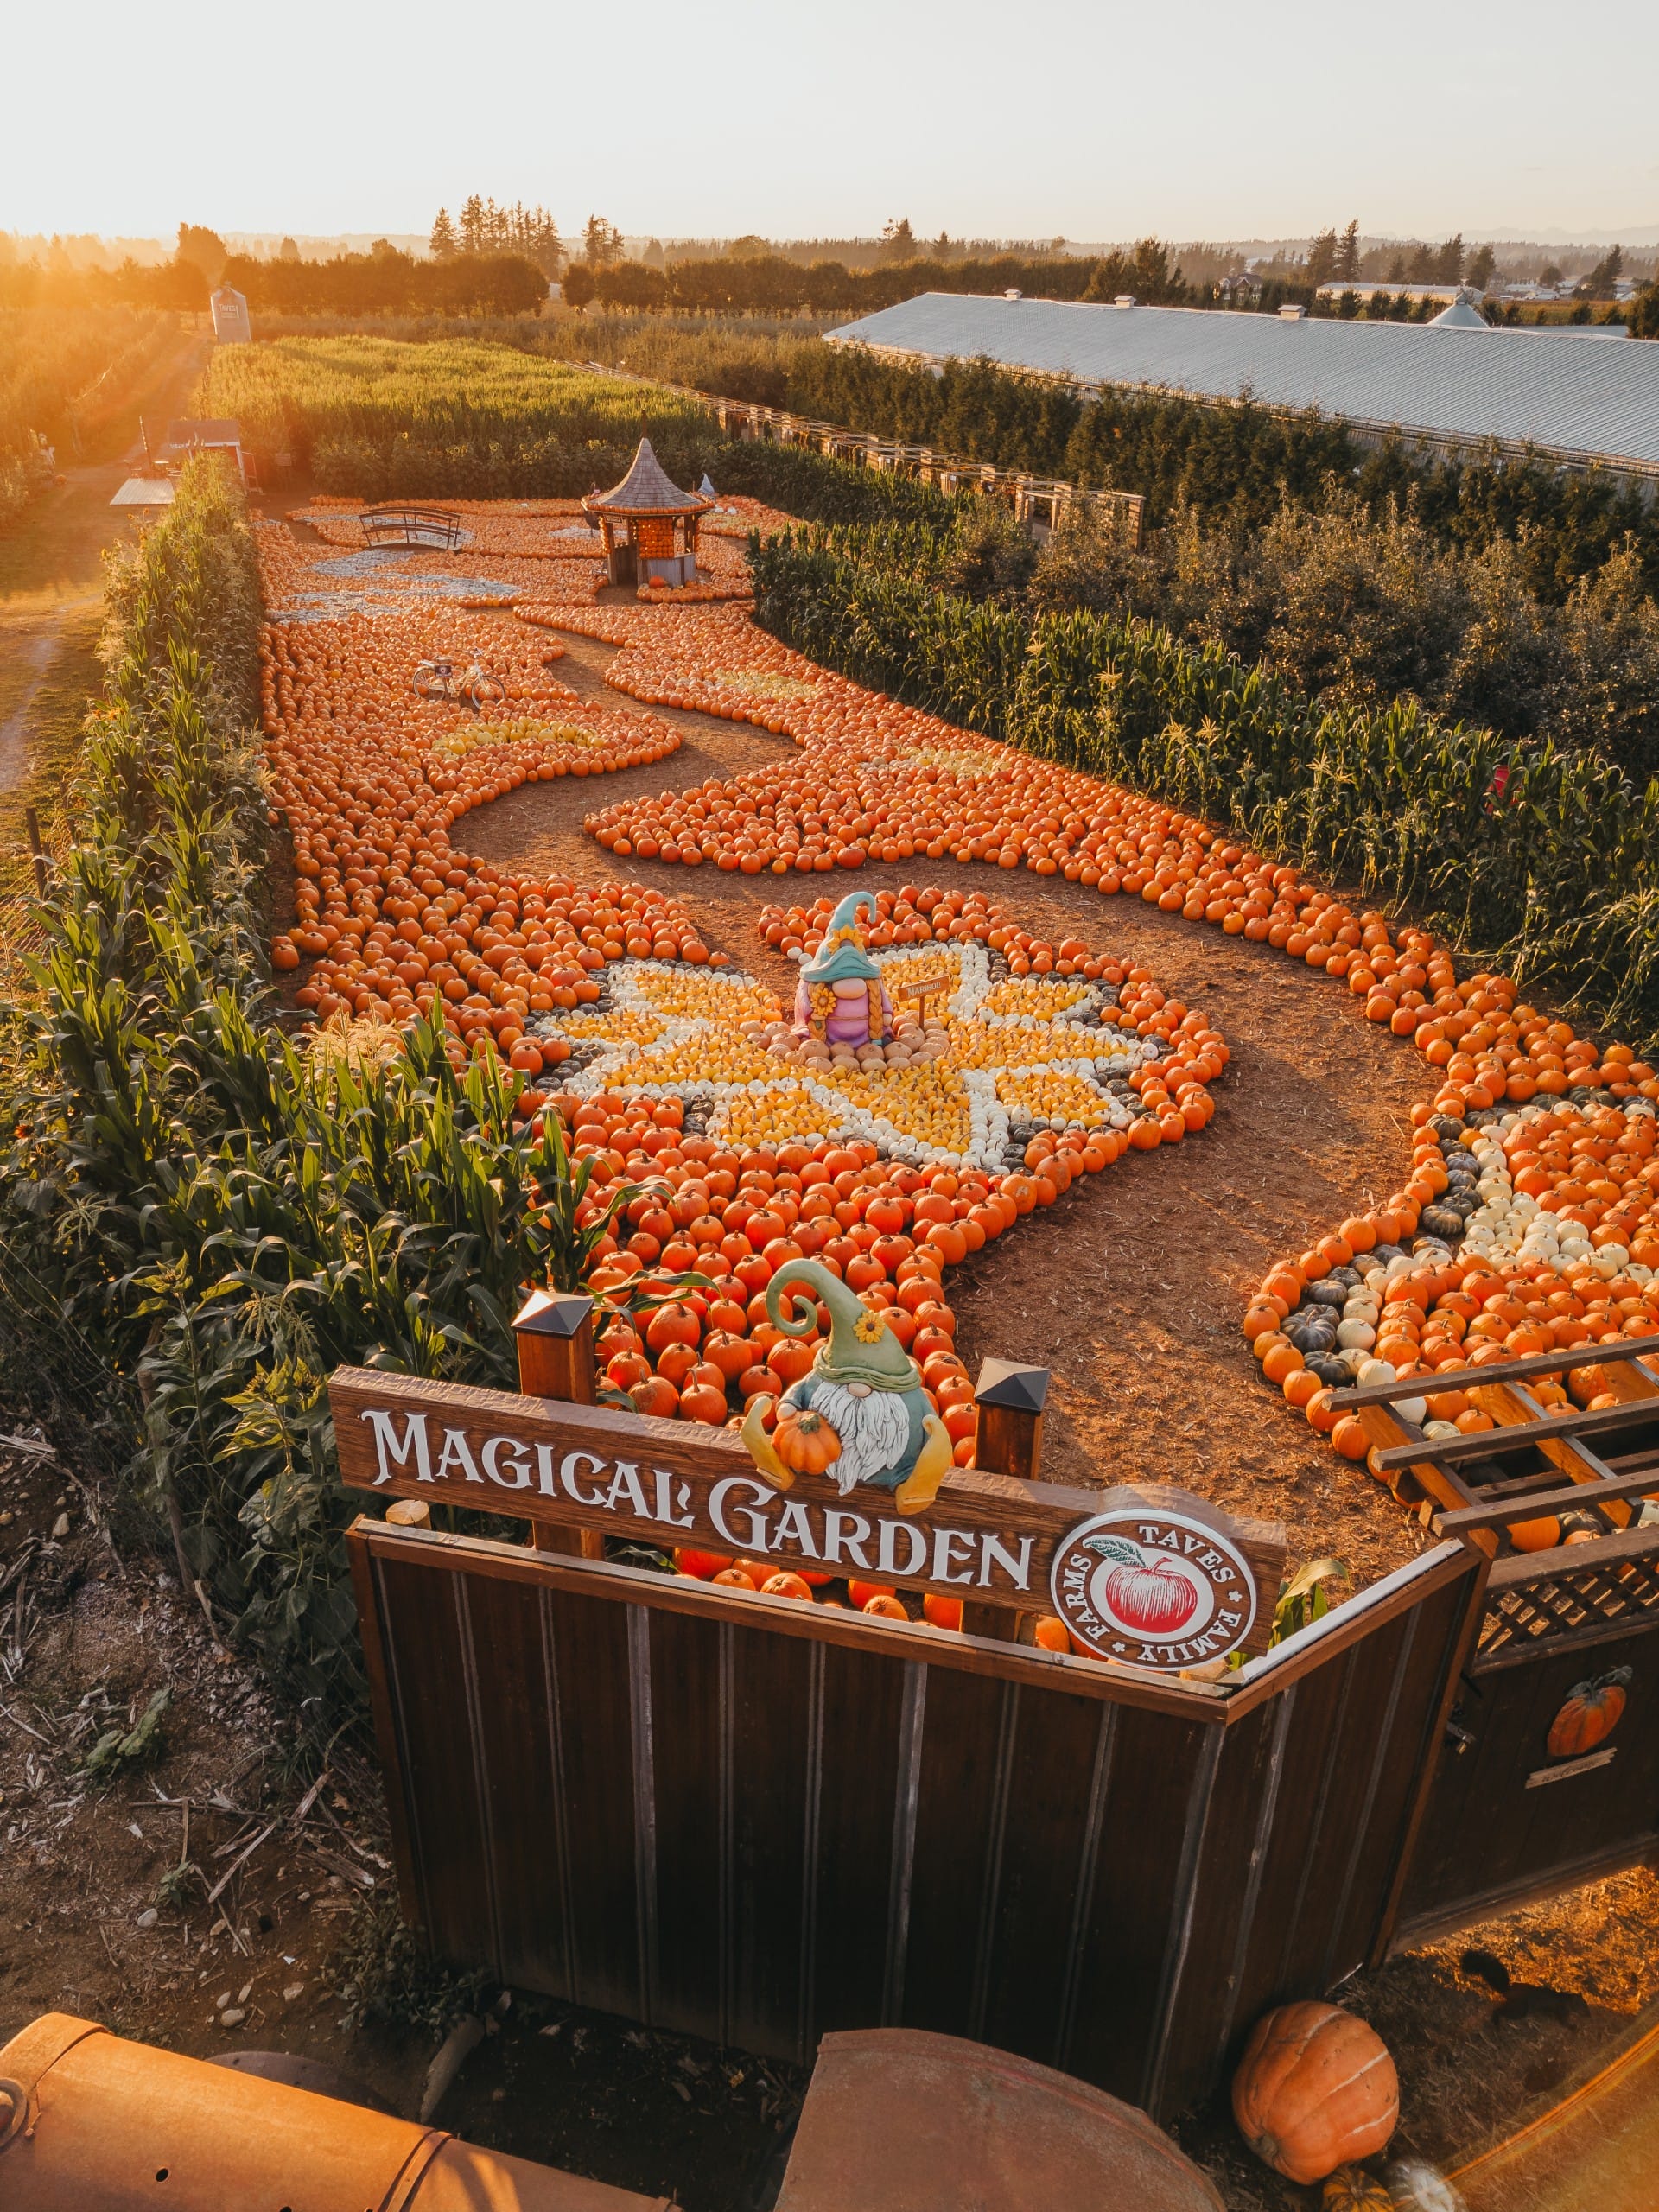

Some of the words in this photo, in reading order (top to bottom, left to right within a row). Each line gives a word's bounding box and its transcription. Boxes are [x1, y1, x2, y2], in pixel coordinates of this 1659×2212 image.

[362, 1410, 695, 1529] MAGICAL
[708, 1477, 1036, 1591] GARDEN
[1138, 1524, 1236, 1584] TAVES
[1063, 1553, 1111, 1641] FARMS
[1136, 1608, 1243, 1662] FAMILY
